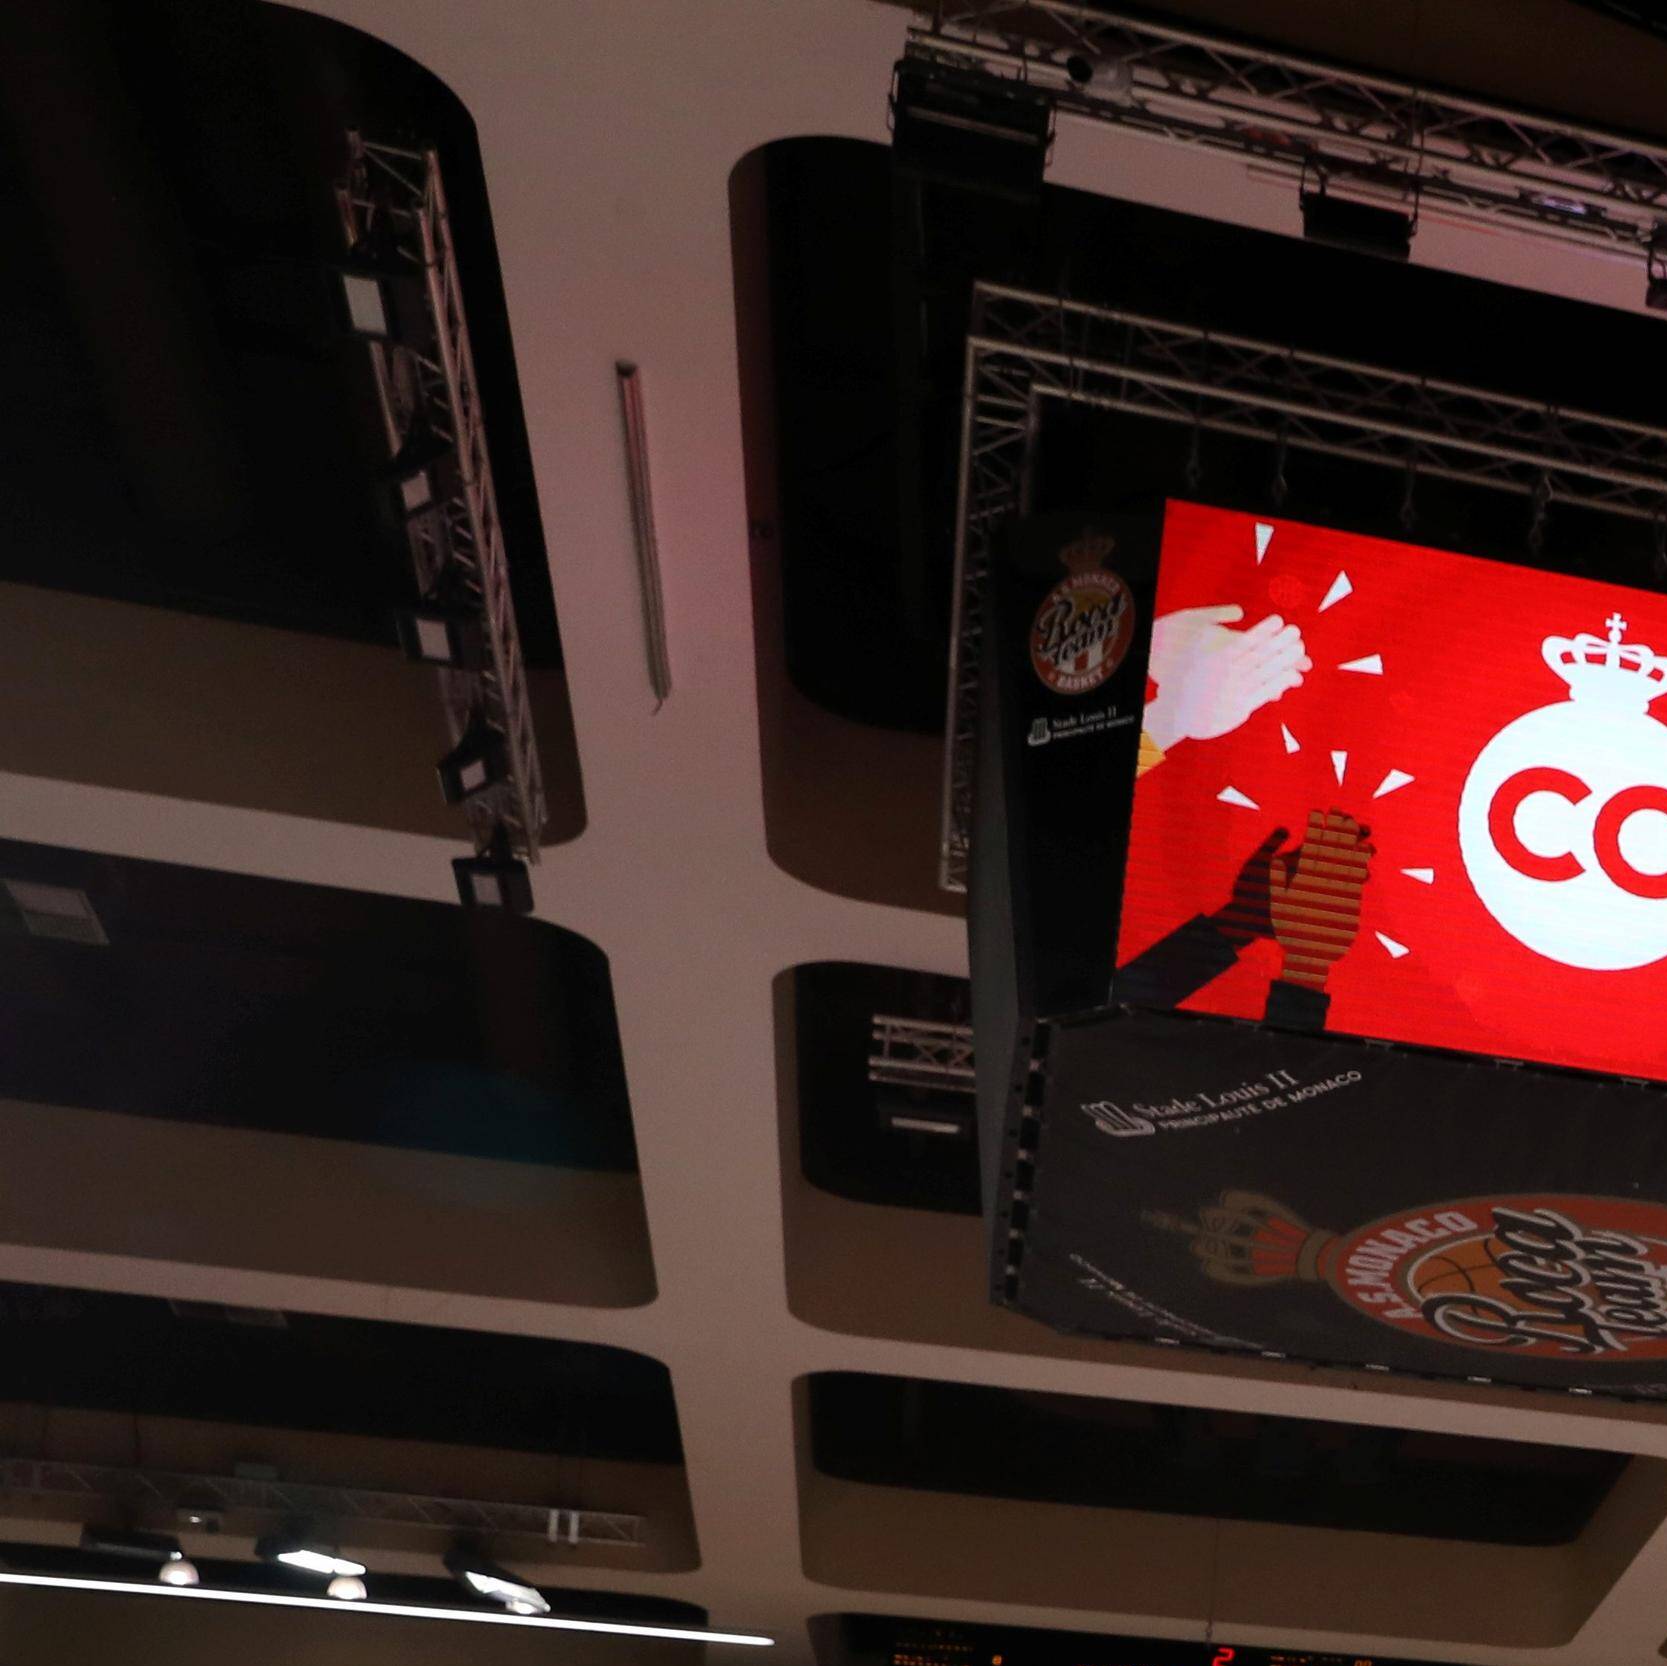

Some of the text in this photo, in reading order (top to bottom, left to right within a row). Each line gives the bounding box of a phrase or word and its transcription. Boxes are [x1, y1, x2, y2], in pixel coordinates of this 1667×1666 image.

[1198, 1081, 1270, 1108] Louis
[1267, 1069, 1300, 1090] II
[1287, 1070, 1363, 1104] MONACO
